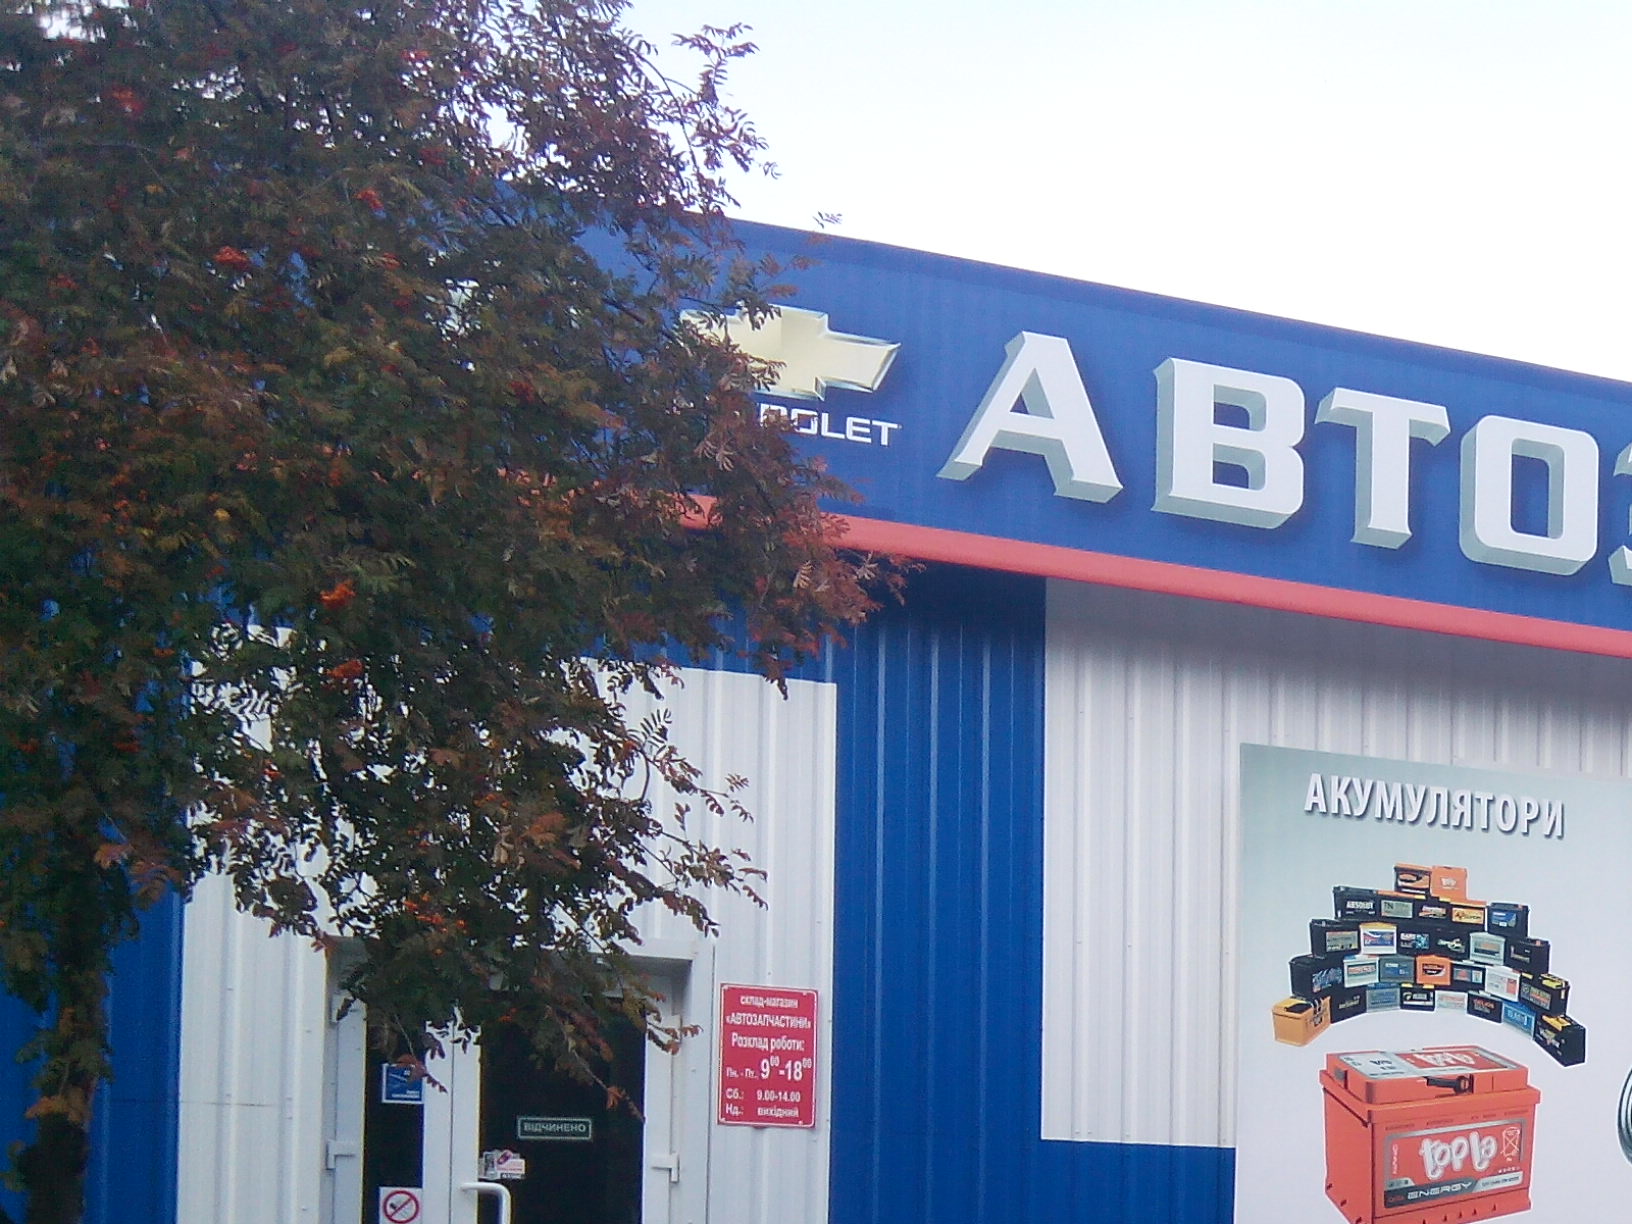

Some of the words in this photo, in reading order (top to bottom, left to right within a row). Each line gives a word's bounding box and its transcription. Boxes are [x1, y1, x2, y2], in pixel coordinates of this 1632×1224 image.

[1304, 772, 1565, 838] АКУМУЛЯТОРИ
[732, 1032, 769, 1051] Розклад
[757, 1089, 801, 1102] 9.00-14.00
[523, 1122, 587, 1133] ВІДЧИНЕНО
[1407, 1181, 1473, 1200] ENERGY
